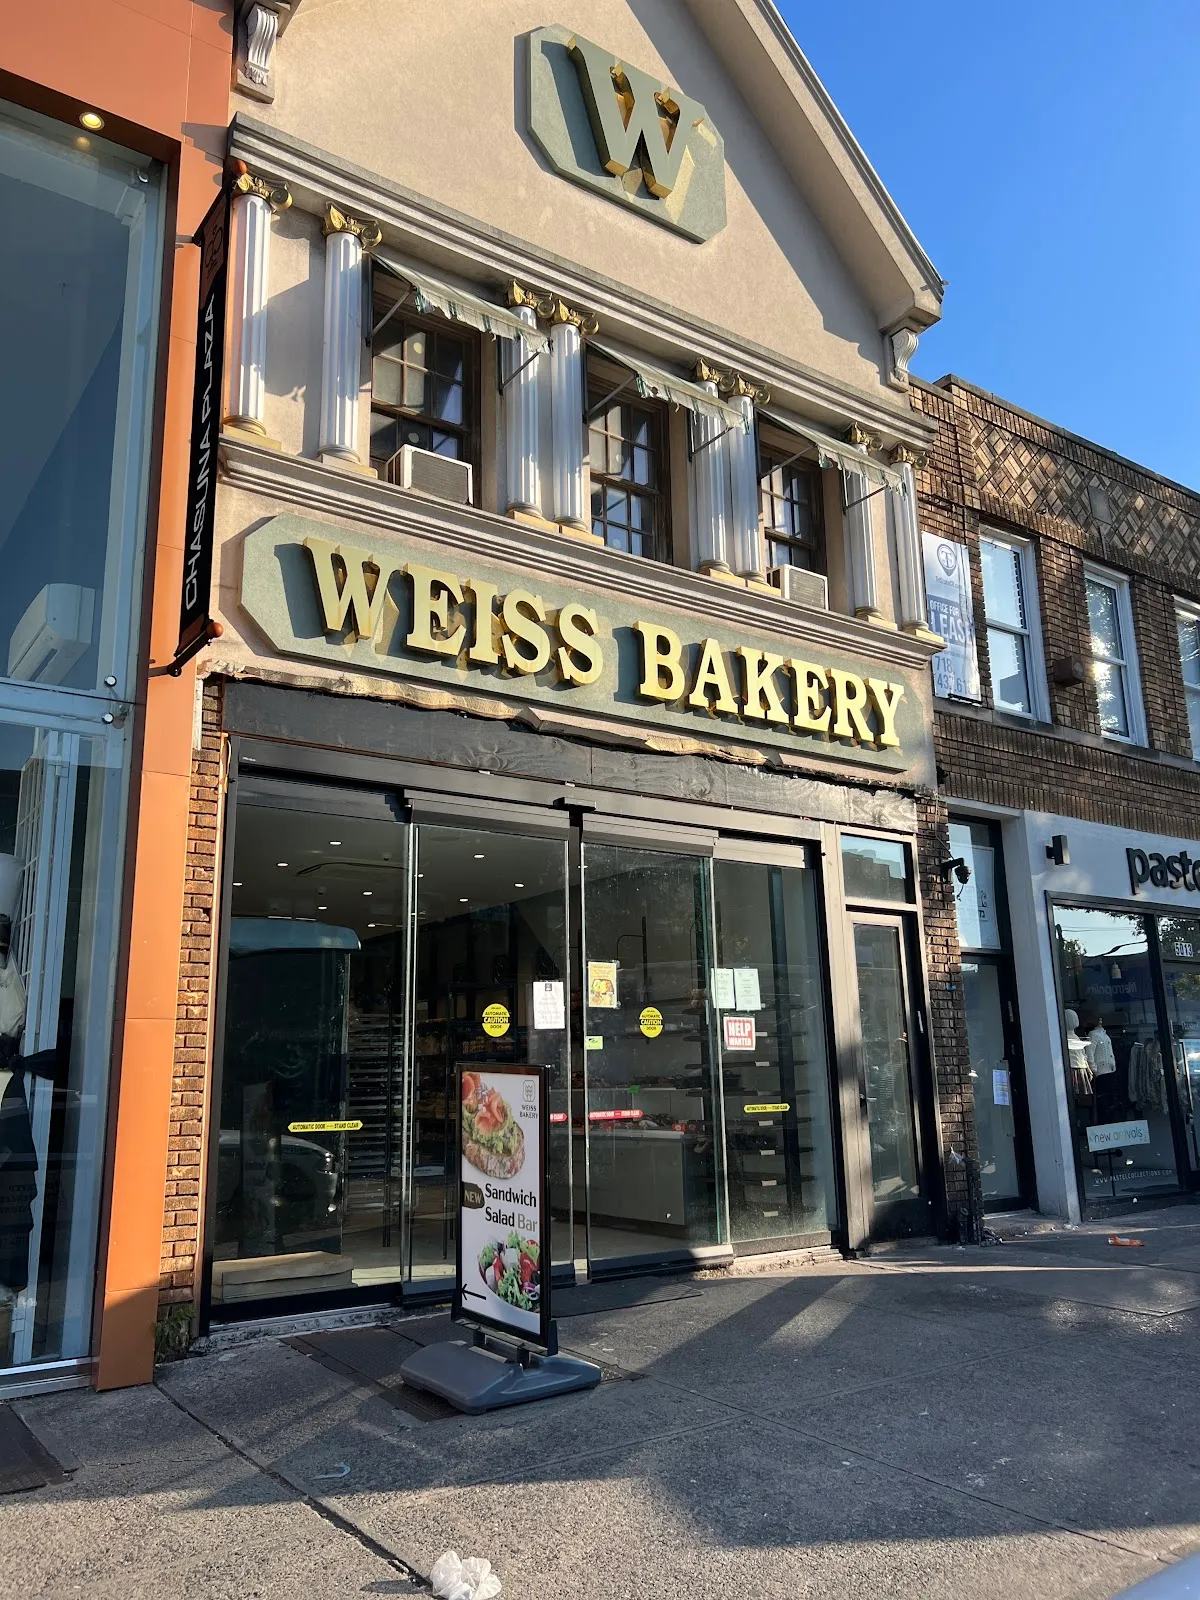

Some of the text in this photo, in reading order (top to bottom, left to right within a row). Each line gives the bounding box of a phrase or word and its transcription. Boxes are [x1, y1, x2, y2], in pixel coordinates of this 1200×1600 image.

[566, 33, 703, 200] W
[185, 420, 211, 610] CHASUNA
[201, 293, 215, 424] PLAZA
[929, 599, 960, 617] OFFICE FOR
[930, 610, 972, 645] LEASE
[303, 536, 904, 747] WEISS BAKERY
[483, 1016, 509, 1024] CAUTION
[728, 1021, 751, 1037] HELP
[729, 1036, 752, 1046] WANTED
[519, 1111, 538, 1119] BAKERY
[521, 1104, 537, 1112] WEISS
[1094, 1132, 1111, 1144] new
[1113, 1127, 1143, 1140] arivals
[464, 1183, 537, 1208] NEW Sandwich
[485, 1206, 538, 1232] Salad Bar
